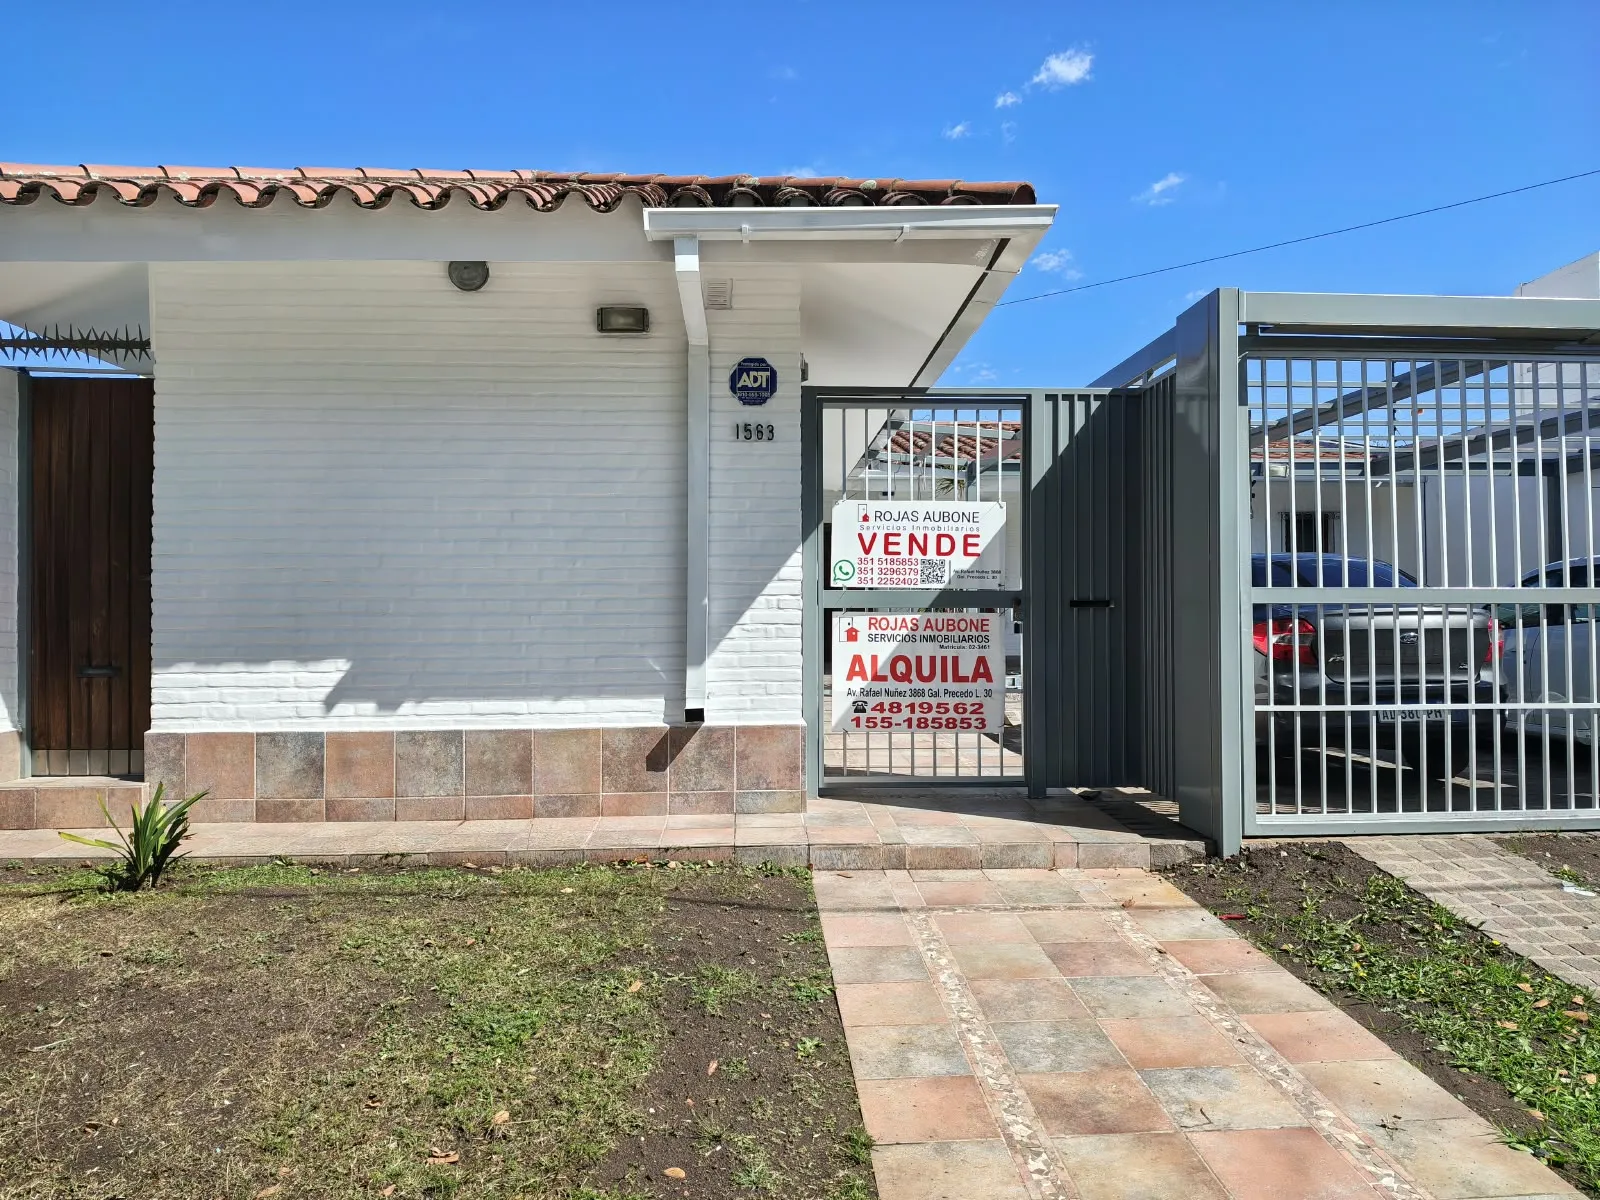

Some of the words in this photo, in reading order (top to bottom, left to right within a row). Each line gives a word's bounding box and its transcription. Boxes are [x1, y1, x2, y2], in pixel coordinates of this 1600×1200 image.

[736, 370, 770, 388] ADT
[736, 423, 774, 441] 1563
[874, 510, 919, 522] ROJAS
[923, 511, 980, 523] AUBONE
[857, 532, 981, 557] VENDE
[857, 557, 874, 566] 351
[877, 557, 919, 567] 5185853
[857, 567, 874, 576] 351
[877, 567, 919, 576] 3296379
[857, 576, 874, 585] 351
[877, 577, 919, 586] 2252402
[868, 617, 919, 632] ROJAS
[923, 618, 990, 633] AUBONE
[867, 633, 917, 643] SERVICIOS
[919, 634, 990, 644] INMOBILIARIOS
[846, 654, 993, 684] ALQUILA
[847, 687, 858, 697] Av.
[859, 687, 883, 698] Rafael
[884, 687, 907, 698] Nuñez
[908, 688, 926, 698] 3868
[927, 688, 942, 698] Gal.
[943, 688, 974, 698] Precedo
[975, 689, 982, 698] L.
[983, 688, 993, 698] 30
[870, 701, 984, 715] 4819562
[851, 715, 987, 730] 155-185853
